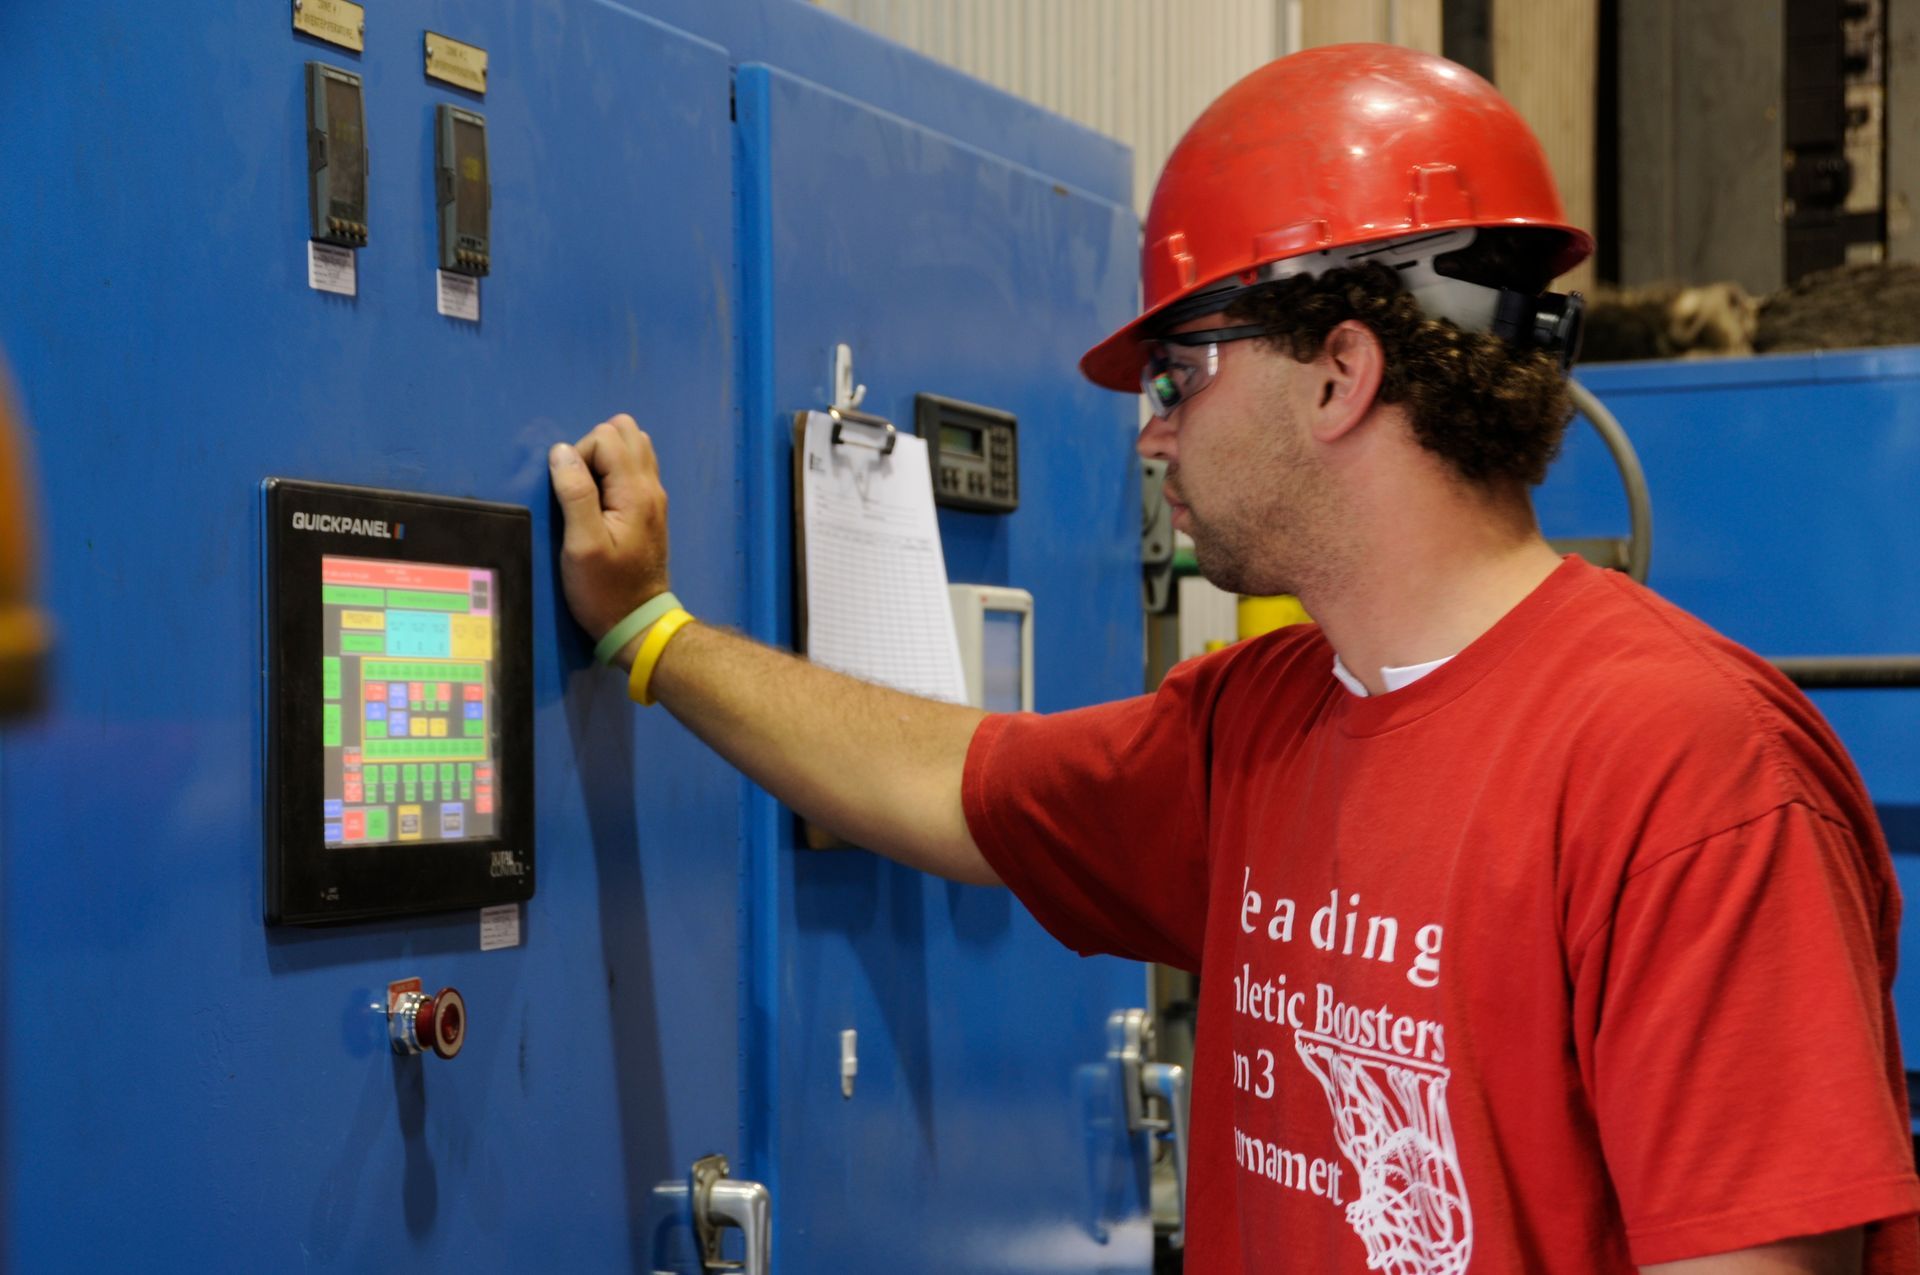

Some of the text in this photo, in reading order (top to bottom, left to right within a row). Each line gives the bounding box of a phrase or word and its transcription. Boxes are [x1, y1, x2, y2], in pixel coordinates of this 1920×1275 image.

[292, 511, 392, 539] QUICKPANEL
[1241, 866, 1444, 988] eading
[1315, 983, 1446, 1063] Boosters
[1255, 1048, 1275, 1099] 3
